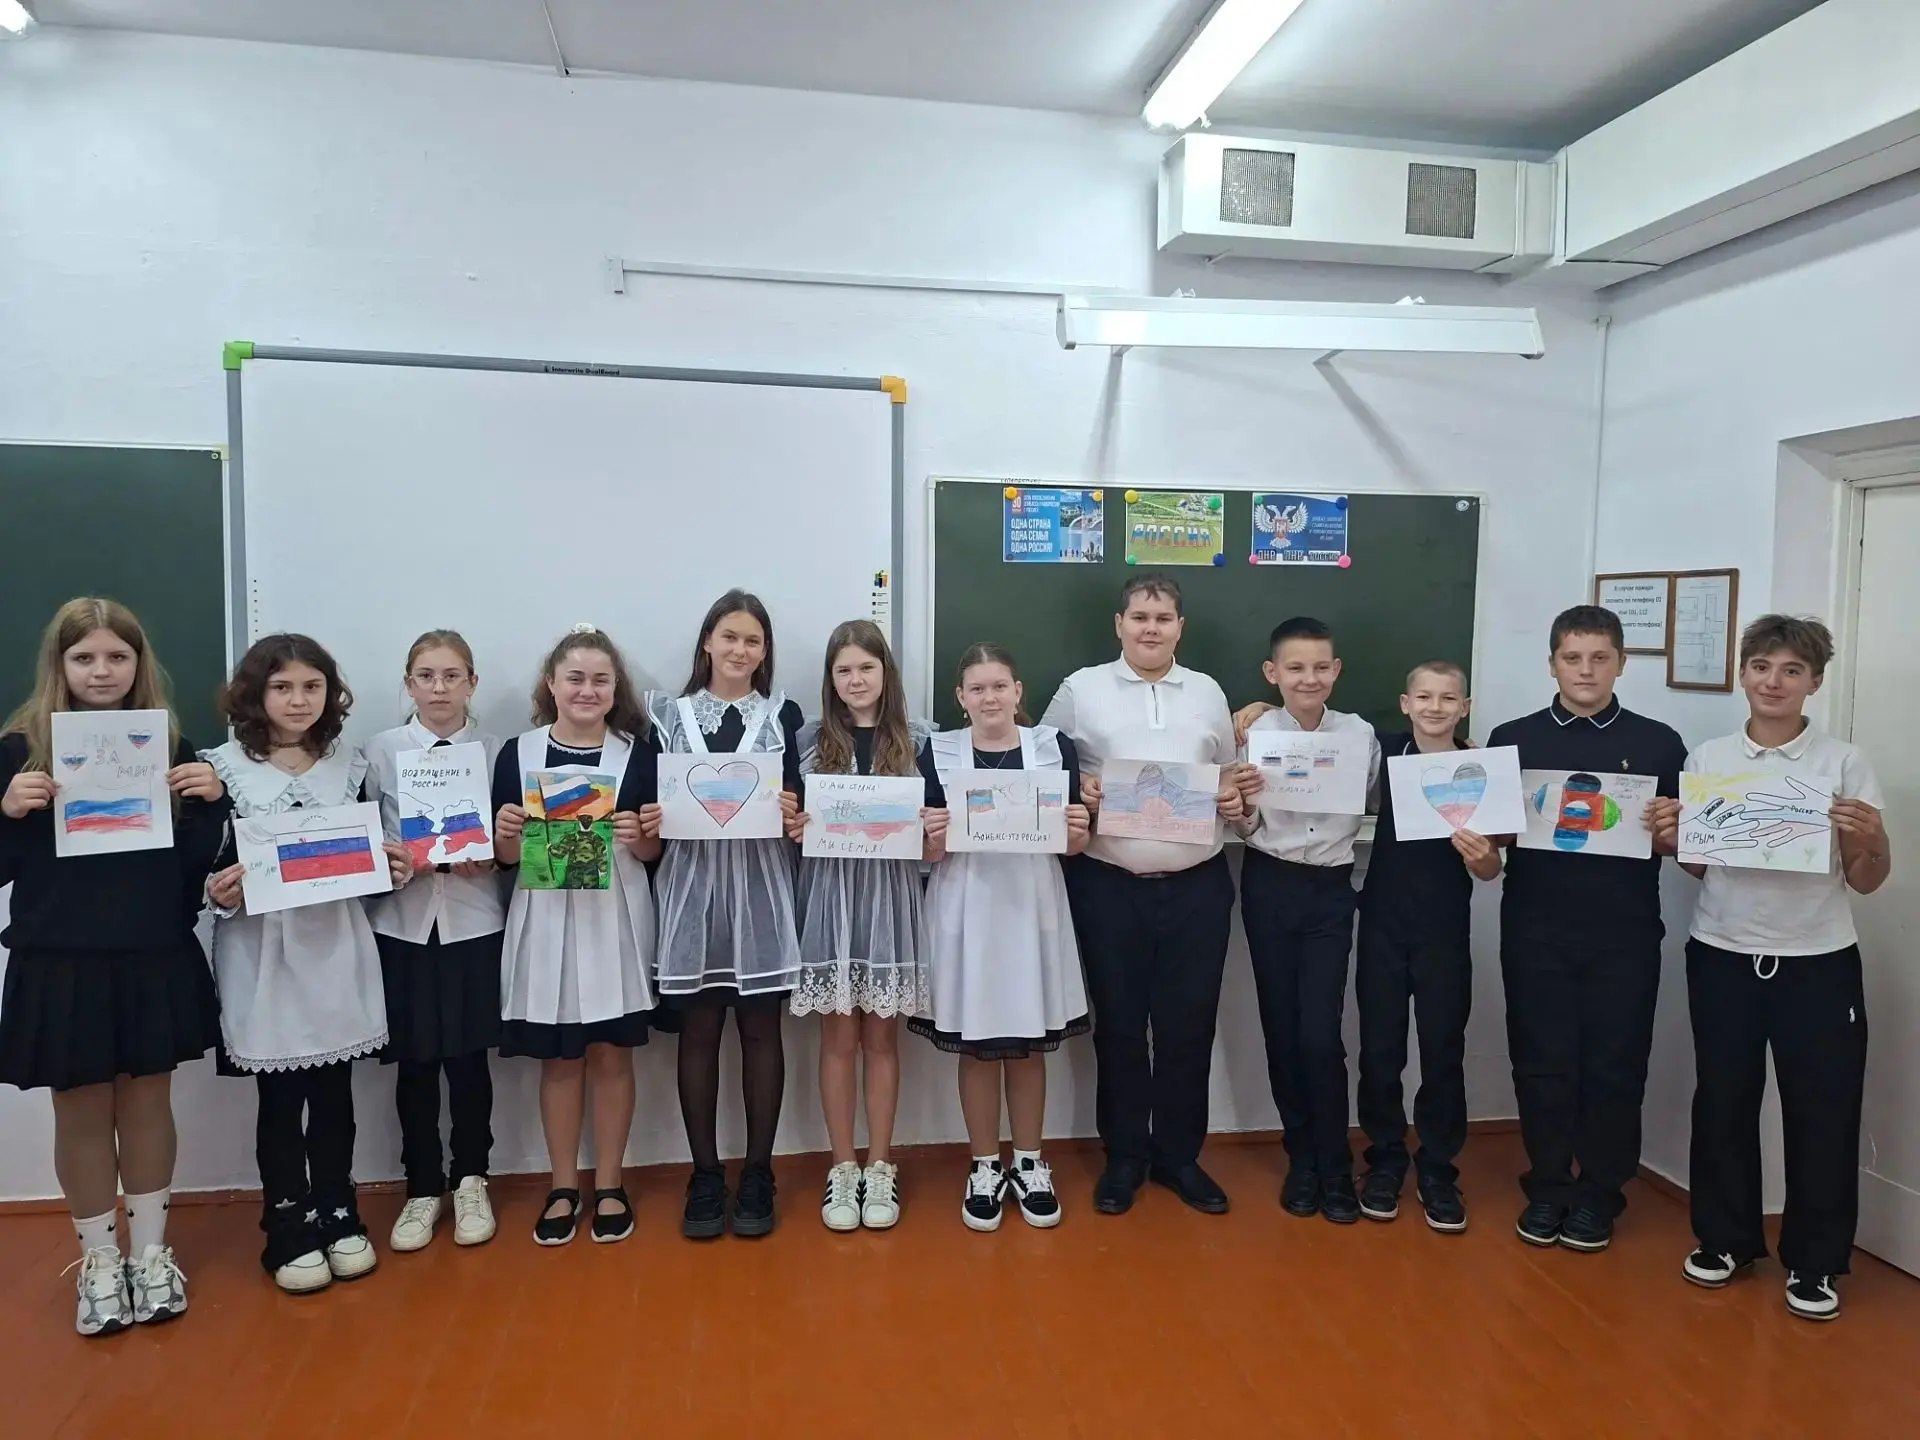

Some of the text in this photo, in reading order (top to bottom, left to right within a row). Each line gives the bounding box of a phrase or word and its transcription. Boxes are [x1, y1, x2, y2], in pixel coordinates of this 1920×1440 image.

[1011, 519, 1051, 529] ОДНА СТРАНА
[1011, 531, 1049, 541] ОДНА СЕМЬЯ
[1131, 524, 1212, 548] РОССИЯ
[1011, 542, 1027, 553] ОДНА
[465, 768, 471, 776] В
[1685, 832, 1715, 845] КРЫМ
